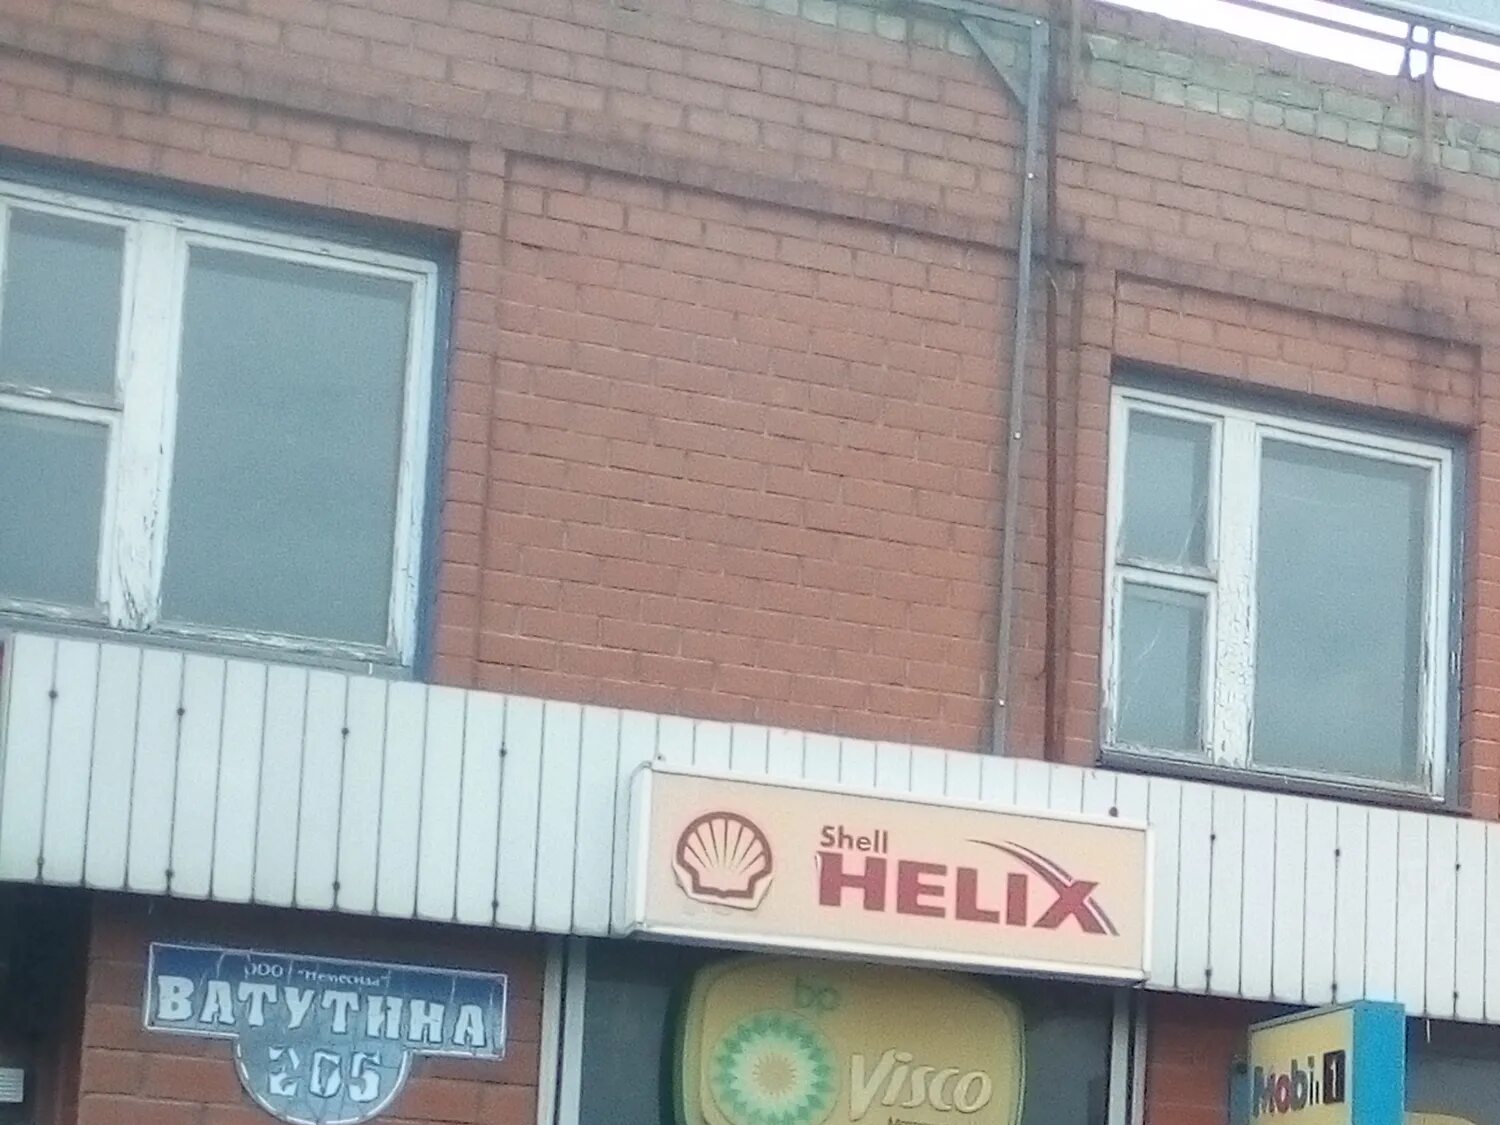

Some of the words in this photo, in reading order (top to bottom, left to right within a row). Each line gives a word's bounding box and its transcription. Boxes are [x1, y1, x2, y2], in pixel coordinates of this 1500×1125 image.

[820, 826, 888, 855] Shell
[815, 842, 1120, 936] HELIX
[157, 975, 486, 1048] ВАТУТИНА
[849, 1048, 993, 1122] Visco
